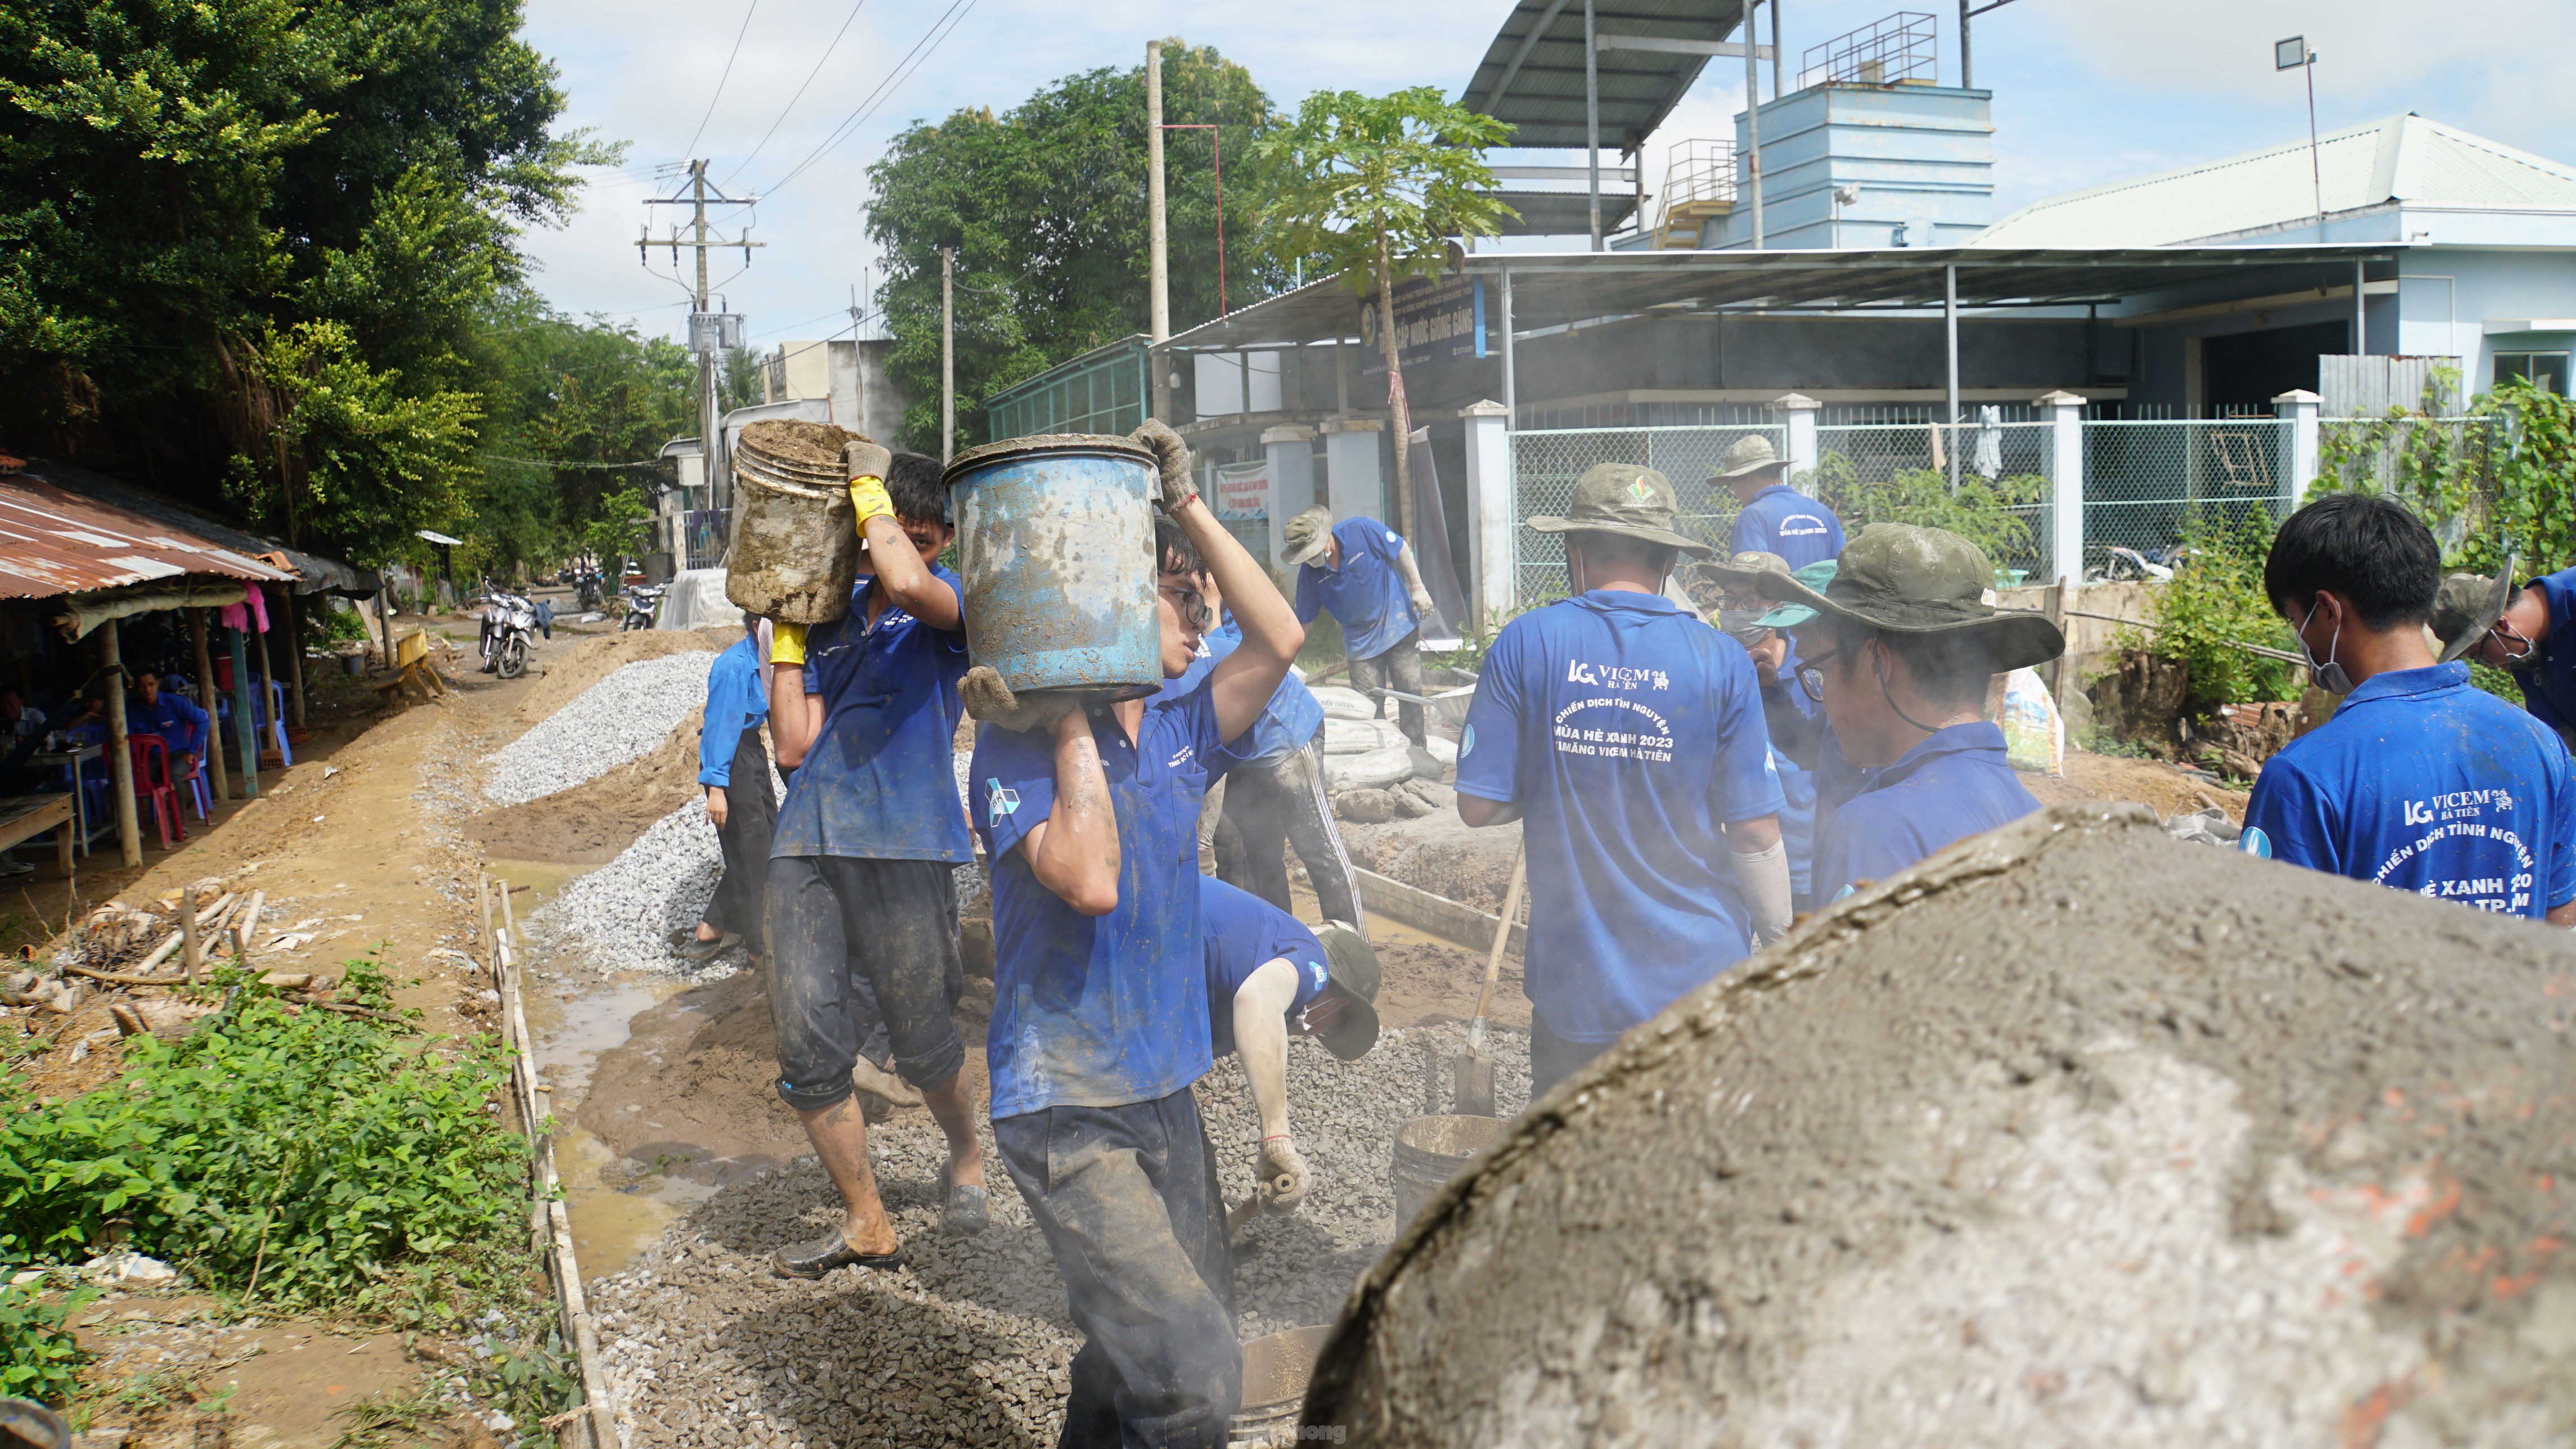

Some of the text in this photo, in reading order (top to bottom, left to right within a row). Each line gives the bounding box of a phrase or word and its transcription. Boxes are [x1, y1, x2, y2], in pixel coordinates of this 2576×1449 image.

[1555, 701, 1585, 723] CHIẾN
[1587, 698, 1612, 708] DỊCH
[1632, 703, 1670, 735] NGUYỆN
[1583, 728, 1604, 742] HÈ
[1605, 732, 1637, 744] XANH
[1639, 735, 1673, 748] 2023
[1630, 747, 1643, 760] HÀ
[1644, 749, 1671, 762] TIÊN
[992, 794, 1002, 808] BK
[2432, 789, 2490, 809] VICEM
[2440, 807, 2480, 821] HÀ TIÊN
[2372, 847, 2413, 886] CHIẾN
[2416, 829, 2445, 853] DỊCH
[2447, 820, 2485, 837] TÌNH
[2441, 878, 2504, 896] XANH
